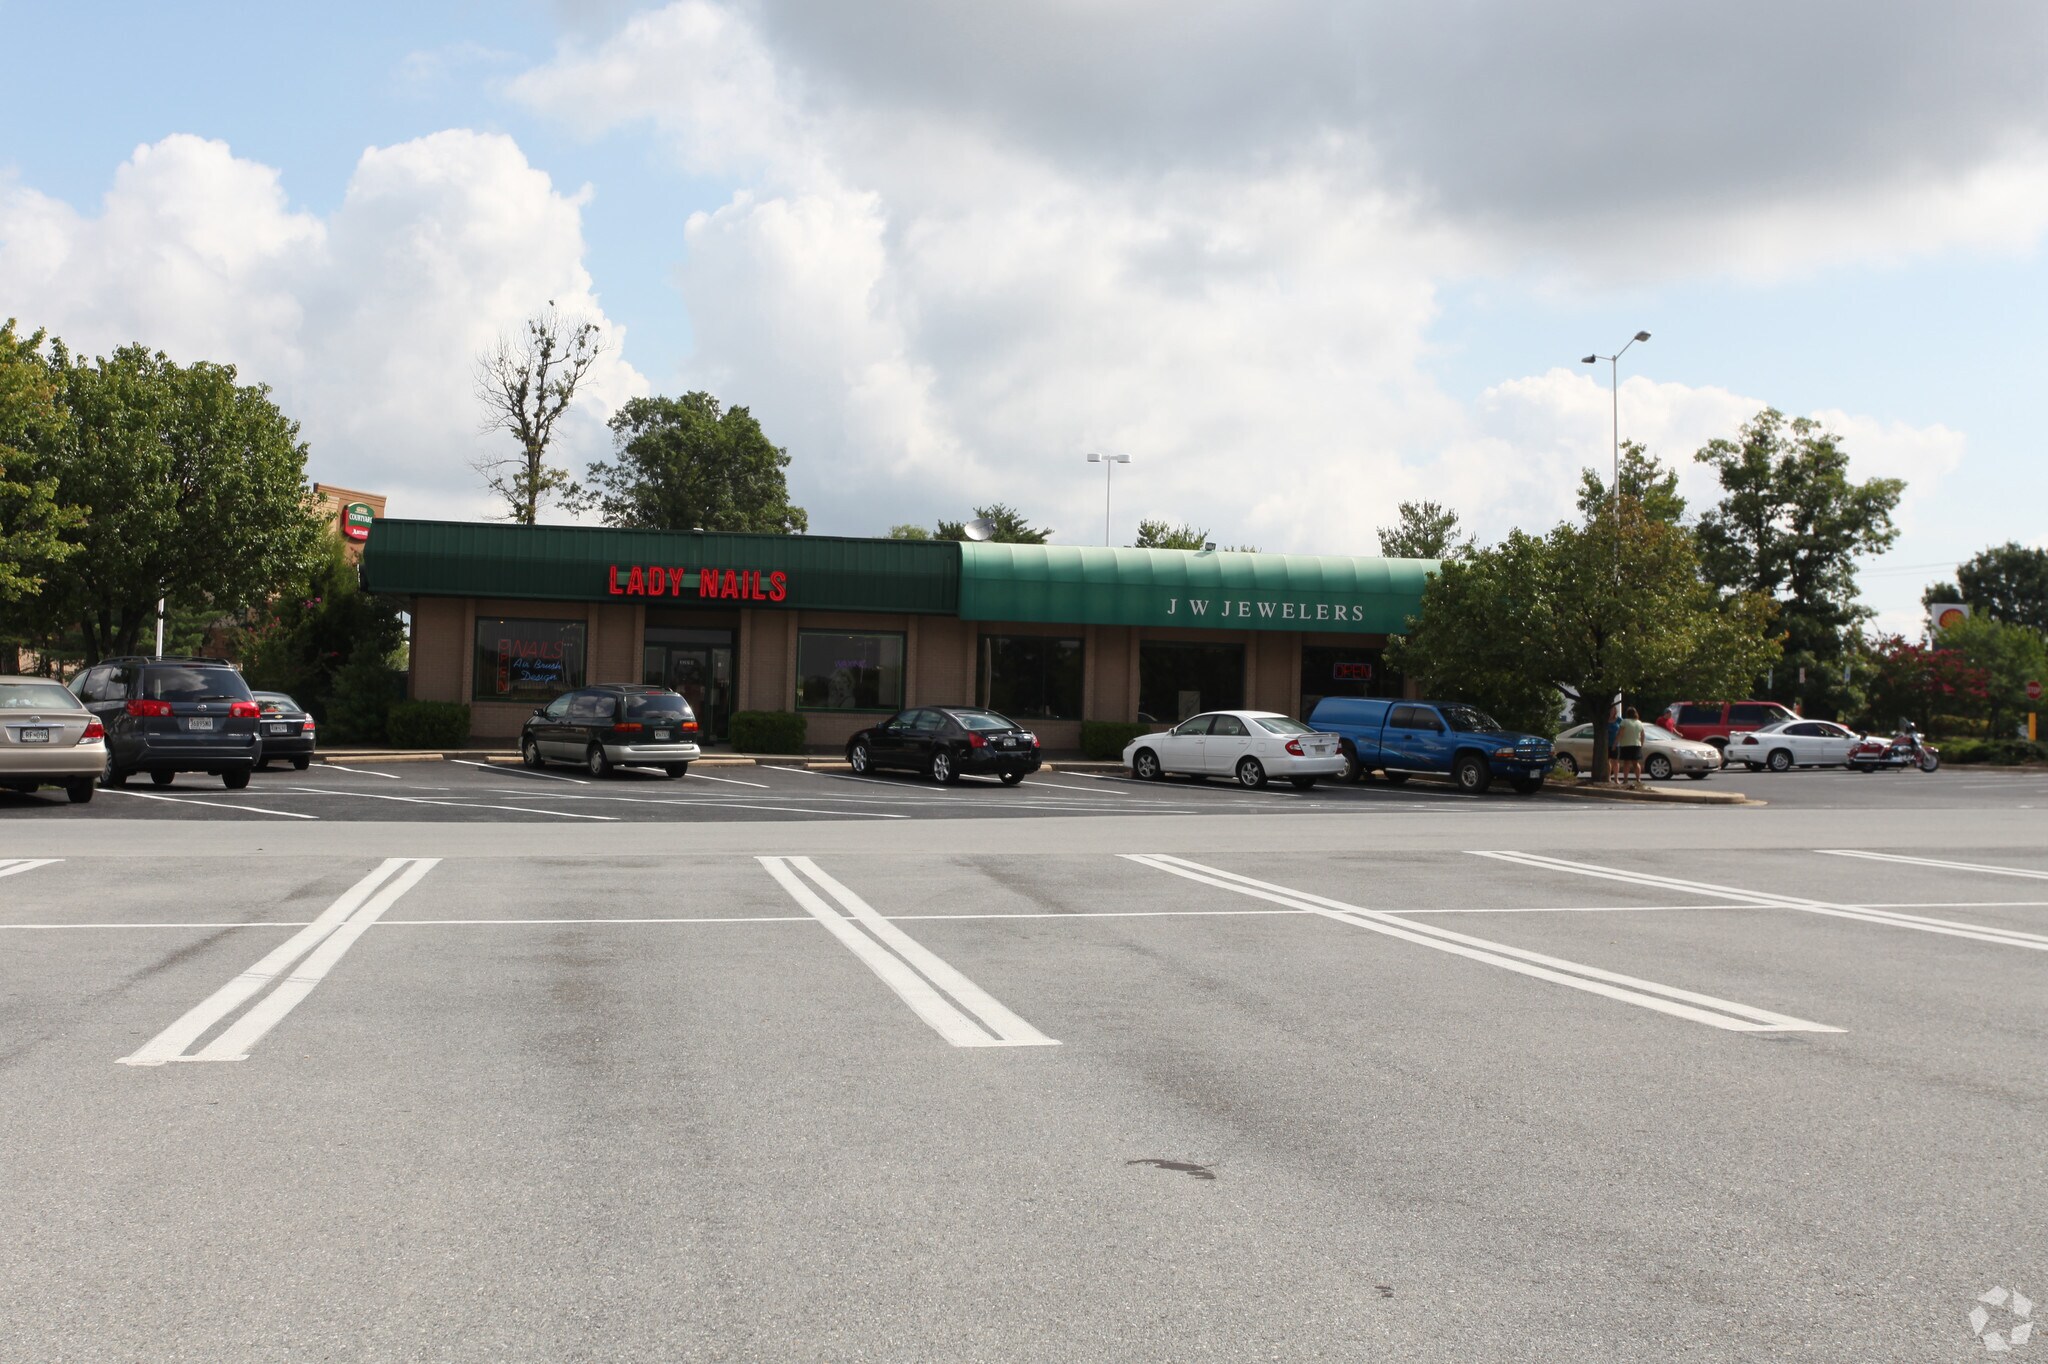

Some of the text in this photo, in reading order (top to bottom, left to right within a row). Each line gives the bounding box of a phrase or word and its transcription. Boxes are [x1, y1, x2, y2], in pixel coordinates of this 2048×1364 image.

[609, 565, 787, 602] LADY NAILS
[1167, 598, 1364, 622] J W JEWELERS
[512, 639, 564, 659] NAILS
[534, 658, 561, 670] Brush
[1335, 663, 1372, 680] OPEN
[520, 670, 558, 685] Design
